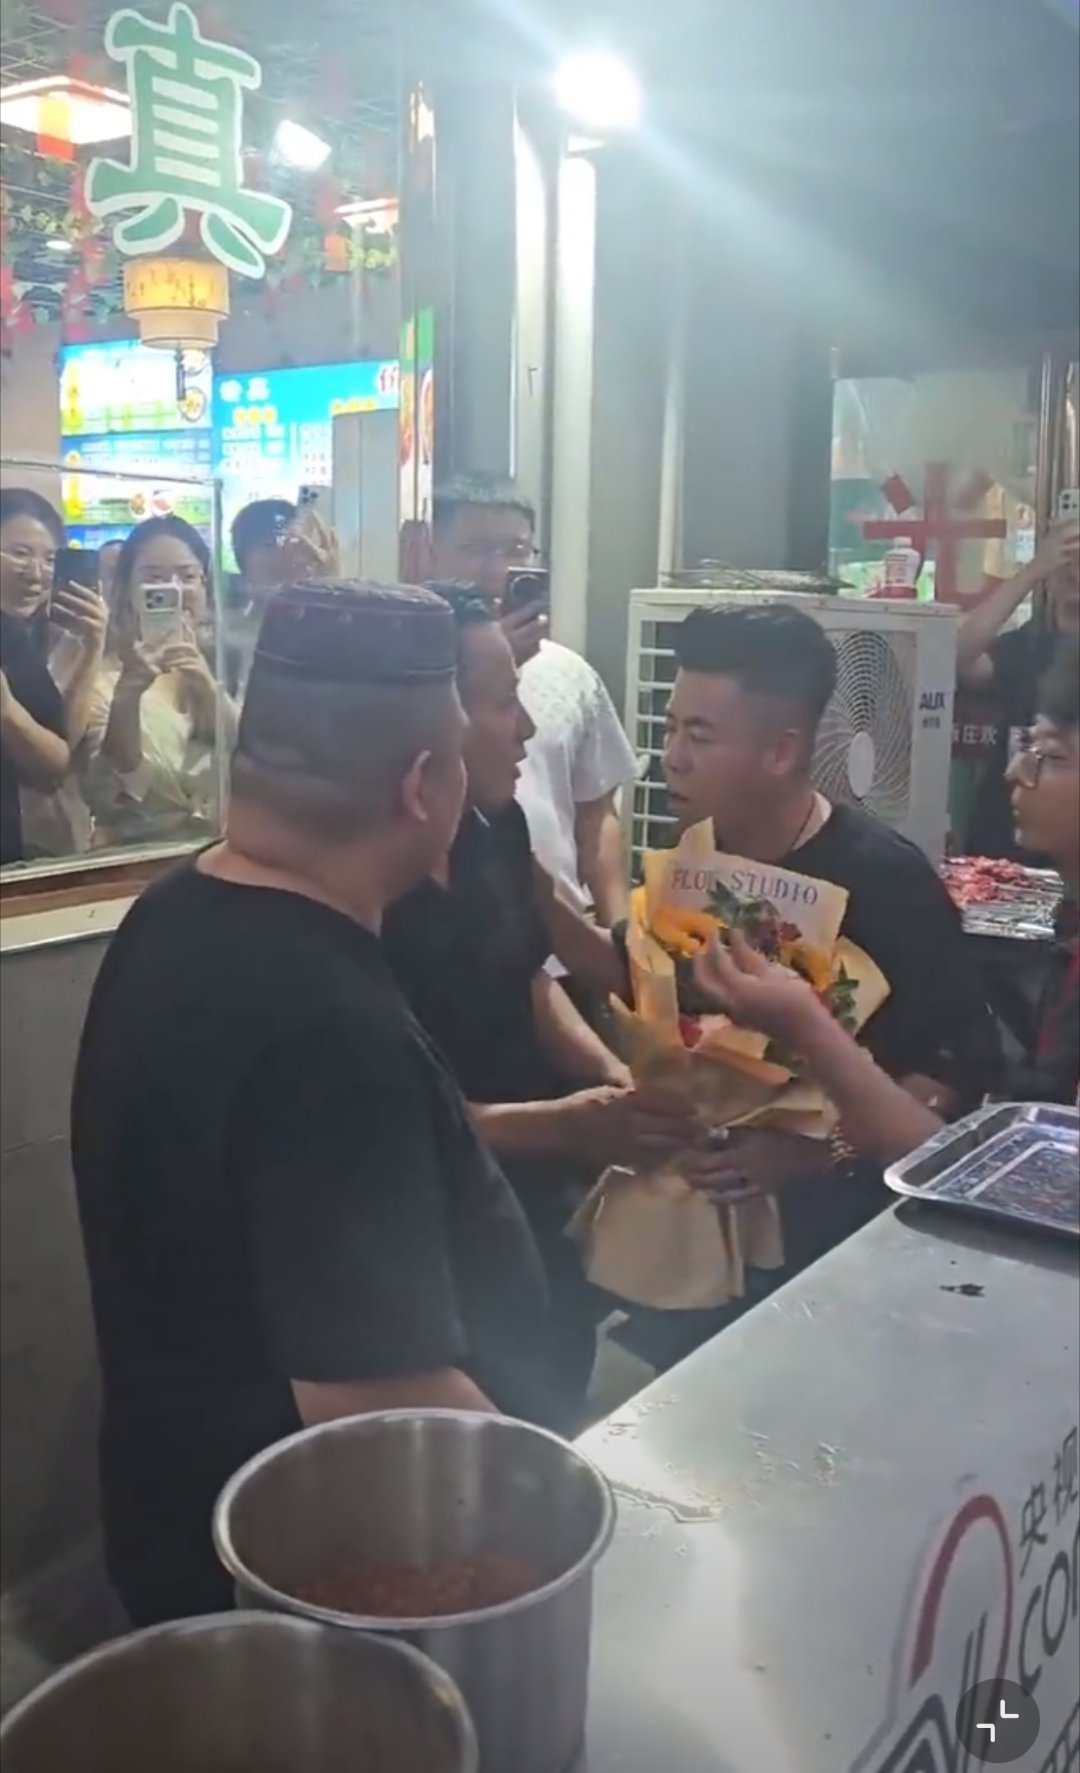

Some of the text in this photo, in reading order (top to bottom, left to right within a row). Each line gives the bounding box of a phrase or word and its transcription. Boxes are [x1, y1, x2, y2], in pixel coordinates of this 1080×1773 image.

[84, 2, 292, 278] 真
[919, 691, 946, 711] AUX
[731, 869, 819, 906] STUDIO
